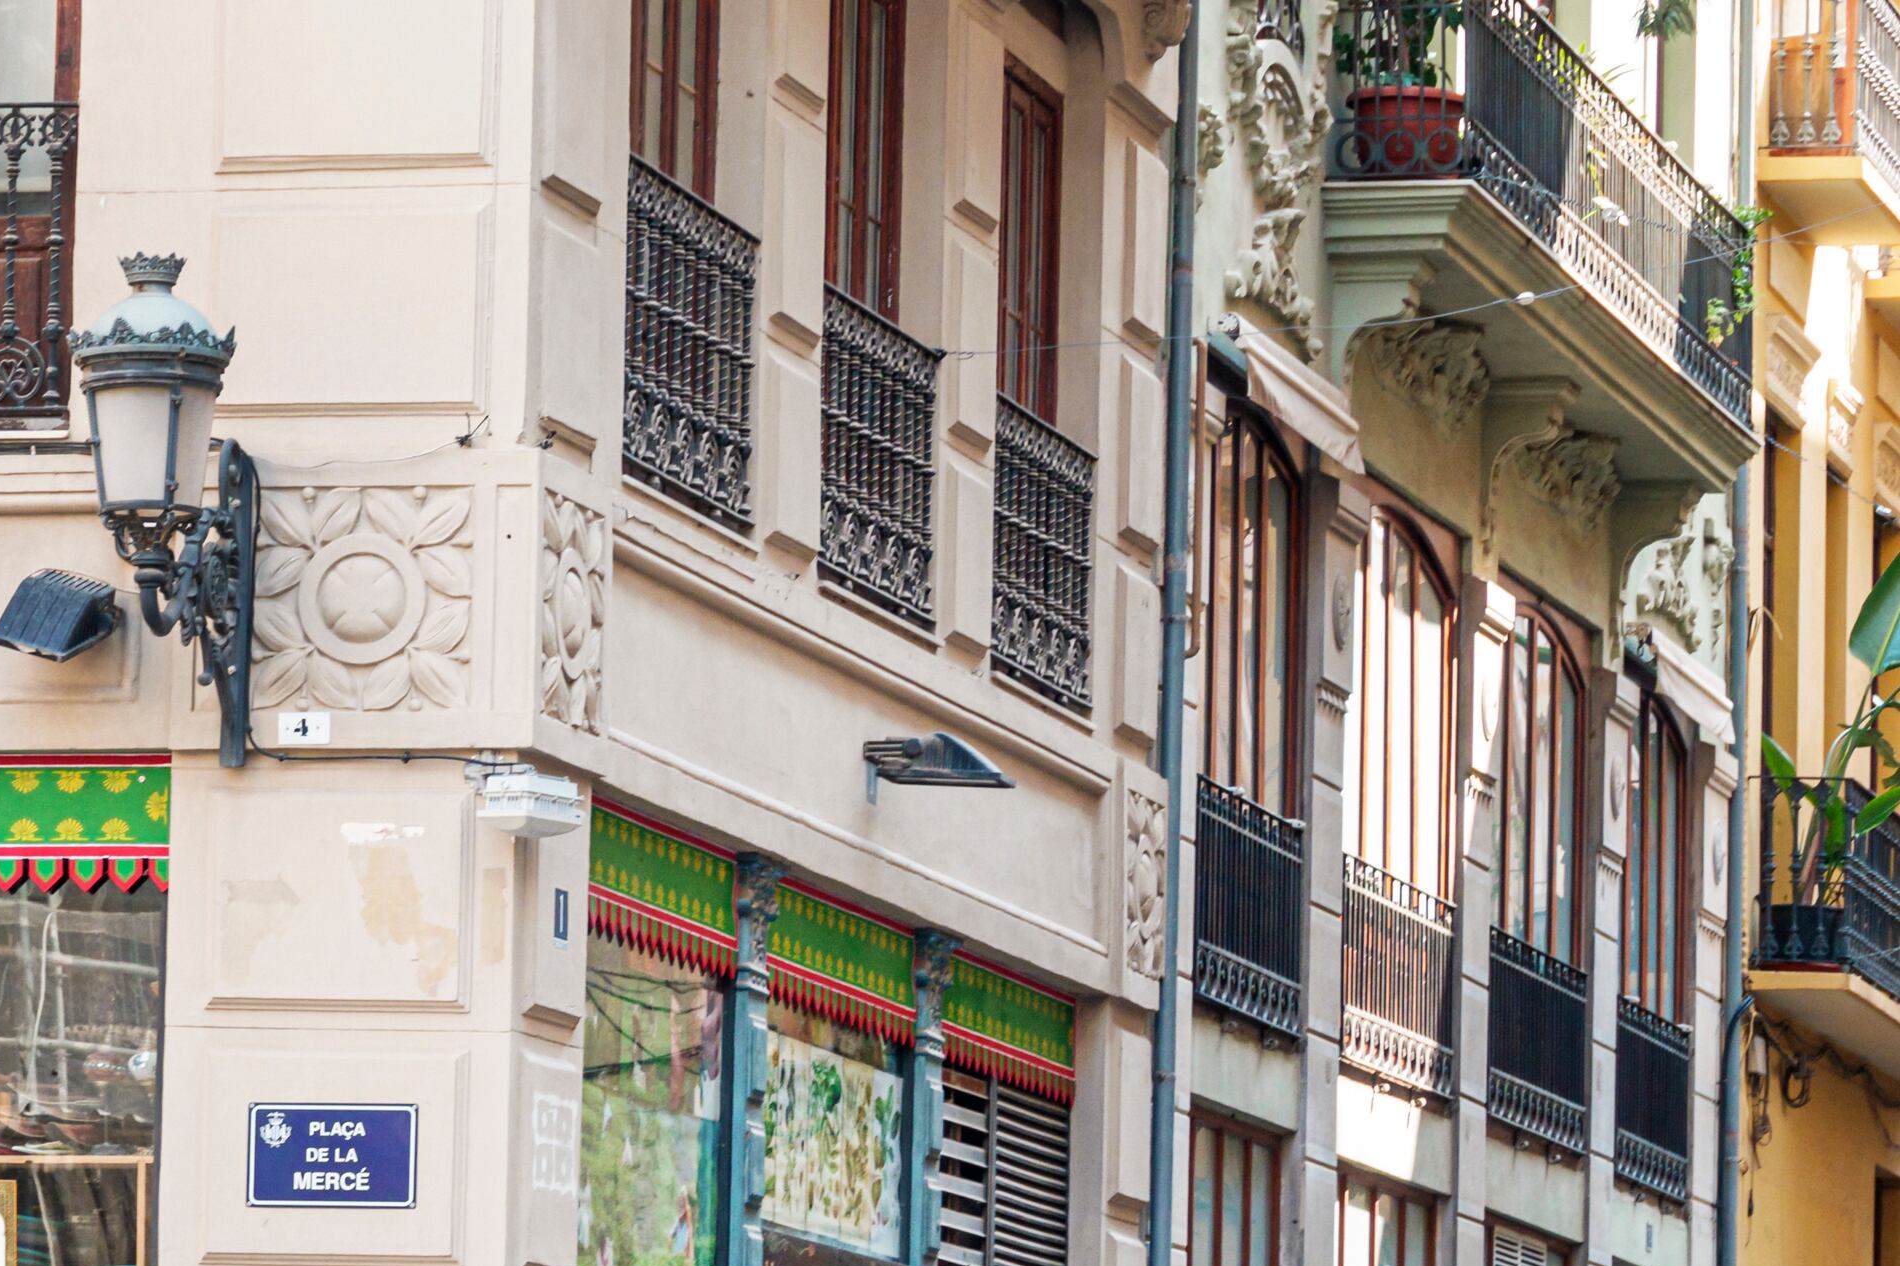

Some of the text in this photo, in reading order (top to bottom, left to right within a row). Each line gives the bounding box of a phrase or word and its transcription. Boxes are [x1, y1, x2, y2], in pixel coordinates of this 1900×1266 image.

[294, 718, 308, 736] 4
[308, 1121, 366, 1140] PLAÇA
[305, 1147, 358, 1163] DE LA
[293, 1167, 370, 1191] MERCÉ
